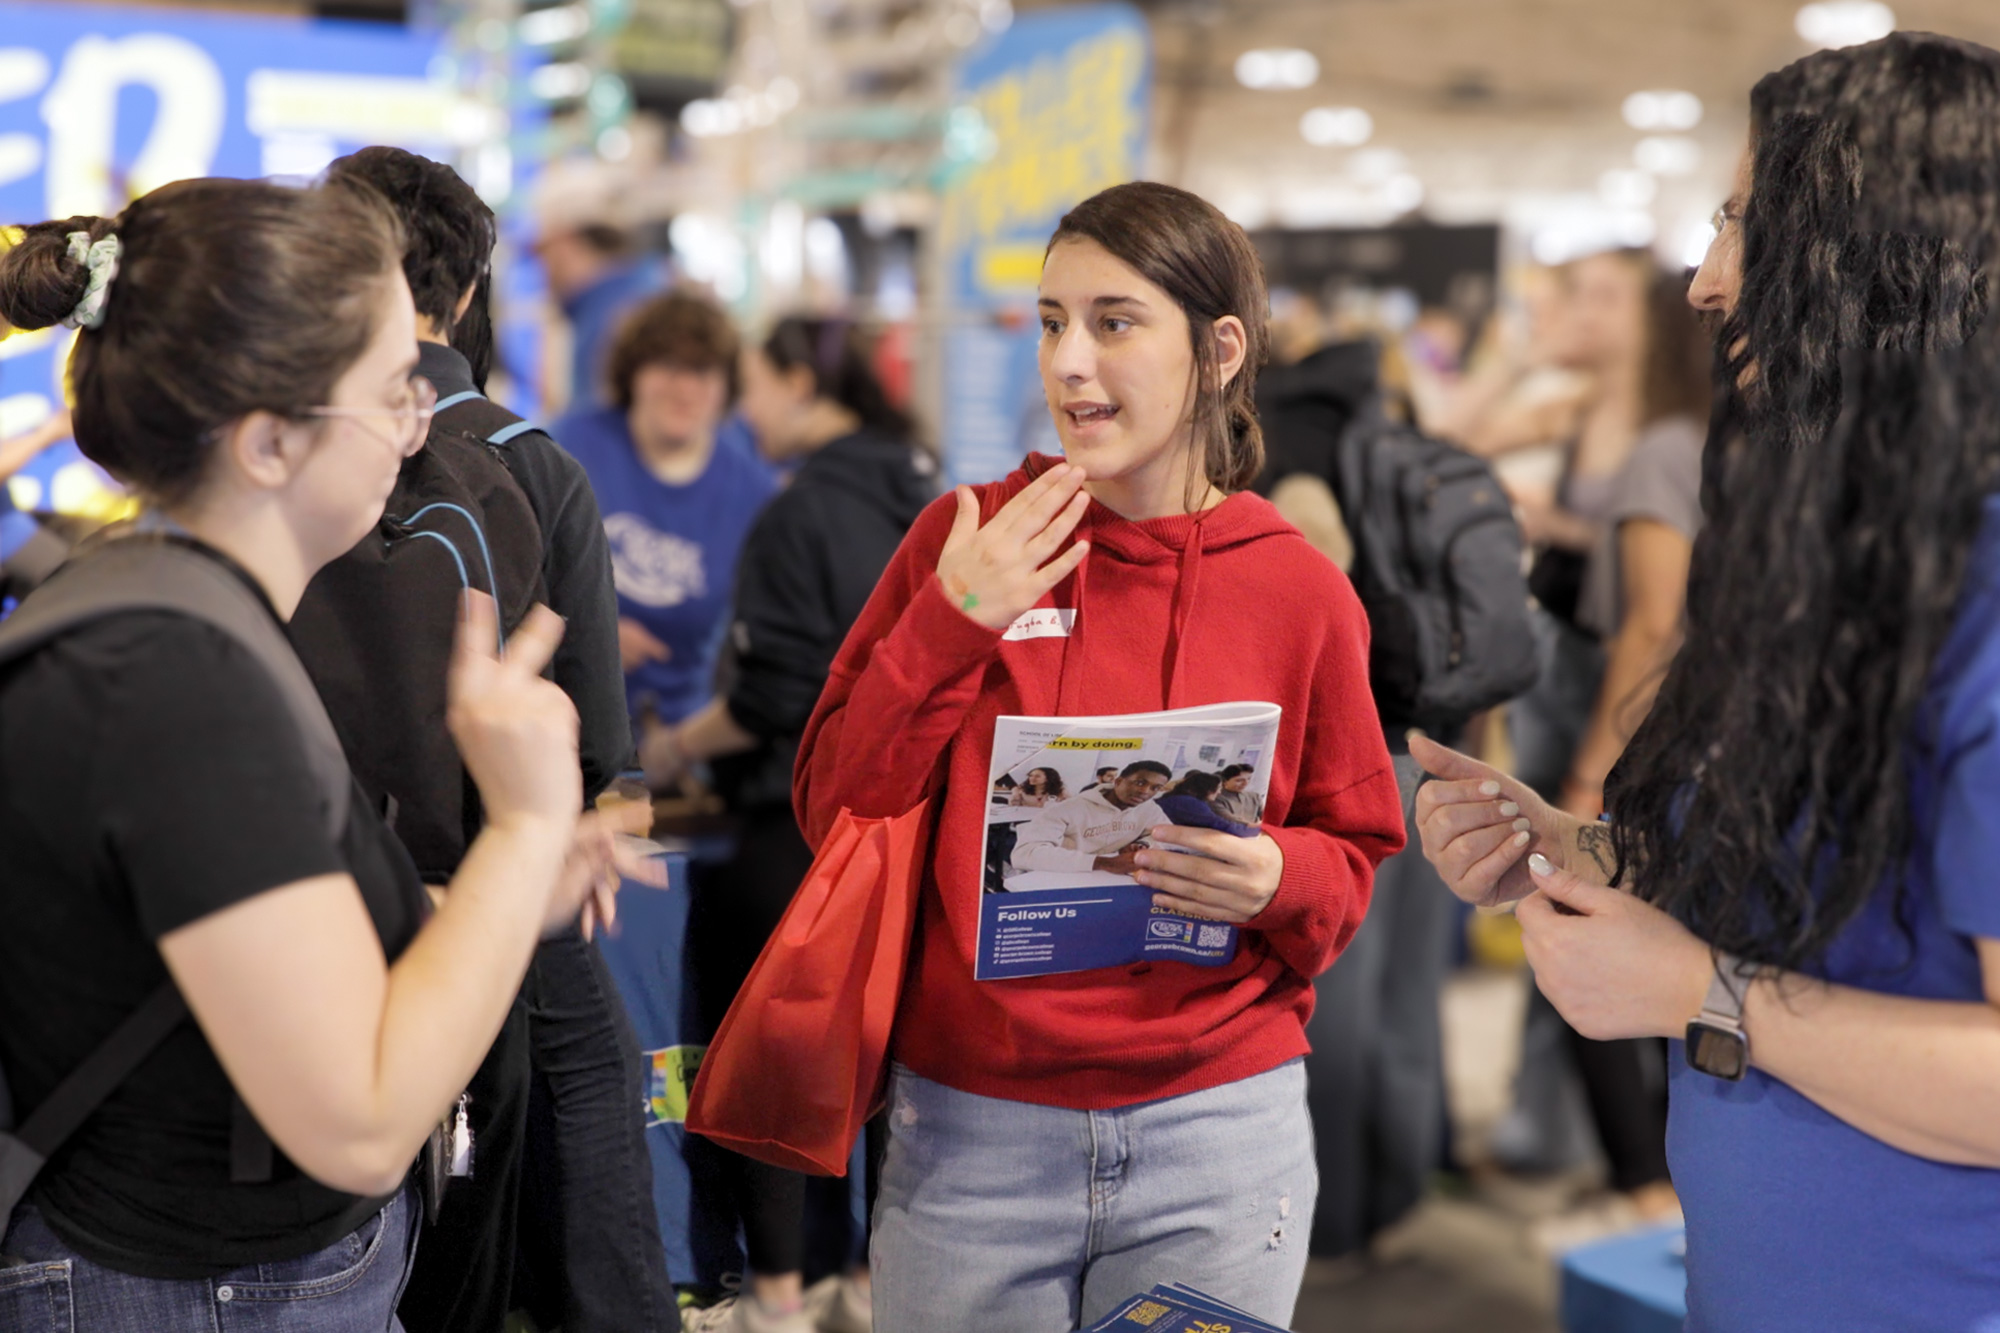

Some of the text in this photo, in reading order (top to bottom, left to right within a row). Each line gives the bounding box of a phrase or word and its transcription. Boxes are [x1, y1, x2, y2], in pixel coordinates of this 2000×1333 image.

[1072, 741, 1088, 749] by
[1092, 741, 1137, 749] doing.
[998, 908, 1077, 922] Follow Us
